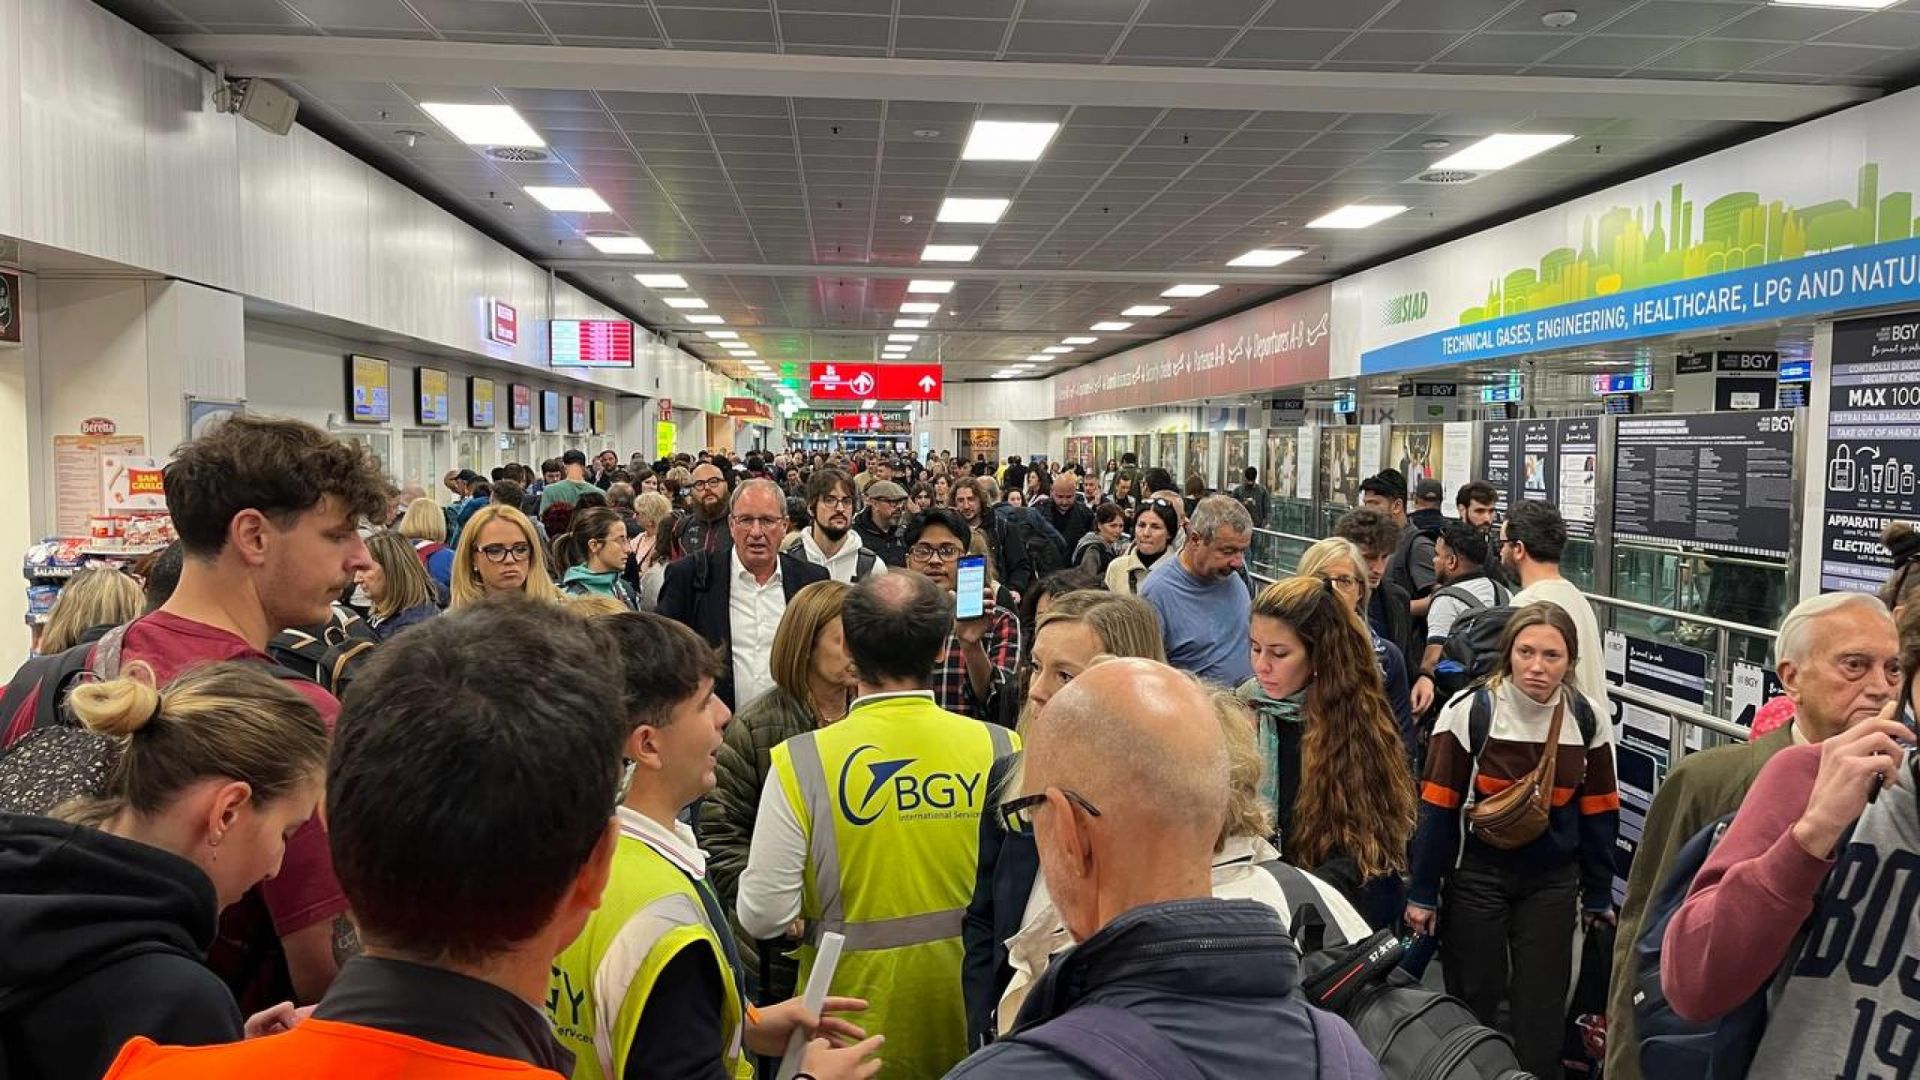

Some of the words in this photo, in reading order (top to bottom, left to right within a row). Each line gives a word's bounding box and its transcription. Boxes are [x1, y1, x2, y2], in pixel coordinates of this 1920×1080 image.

[1402, 291, 1429, 323] SIAD
[1442, 331, 1494, 355] TECHNICAL
[1497, 323, 1533, 346] GASES,
[1537, 305, 1628, 340] ENGINEERING,
[1633, 285, 1746, 325] HEALTHCARE,
[1753, 277, 1791, 308] LPG
[1797, 268, 1843, 301] AND
[1851, 254, 1920, 294] NATU
[1892, 324, 1919, 341] BGY
[1741, 354, 1772, 368] BGY
[1848, 388, 1887, 408] MAX
[1892, 386, 1920, 406] 100
[137, 475, 159, 483] SAN
[1828, 515, 1879, 530] APPARATI
[1832, 540, 1893, 557] ELECTRICA
[894, 772, 982, 811] BGY
[899, 811, 952, 822] International
